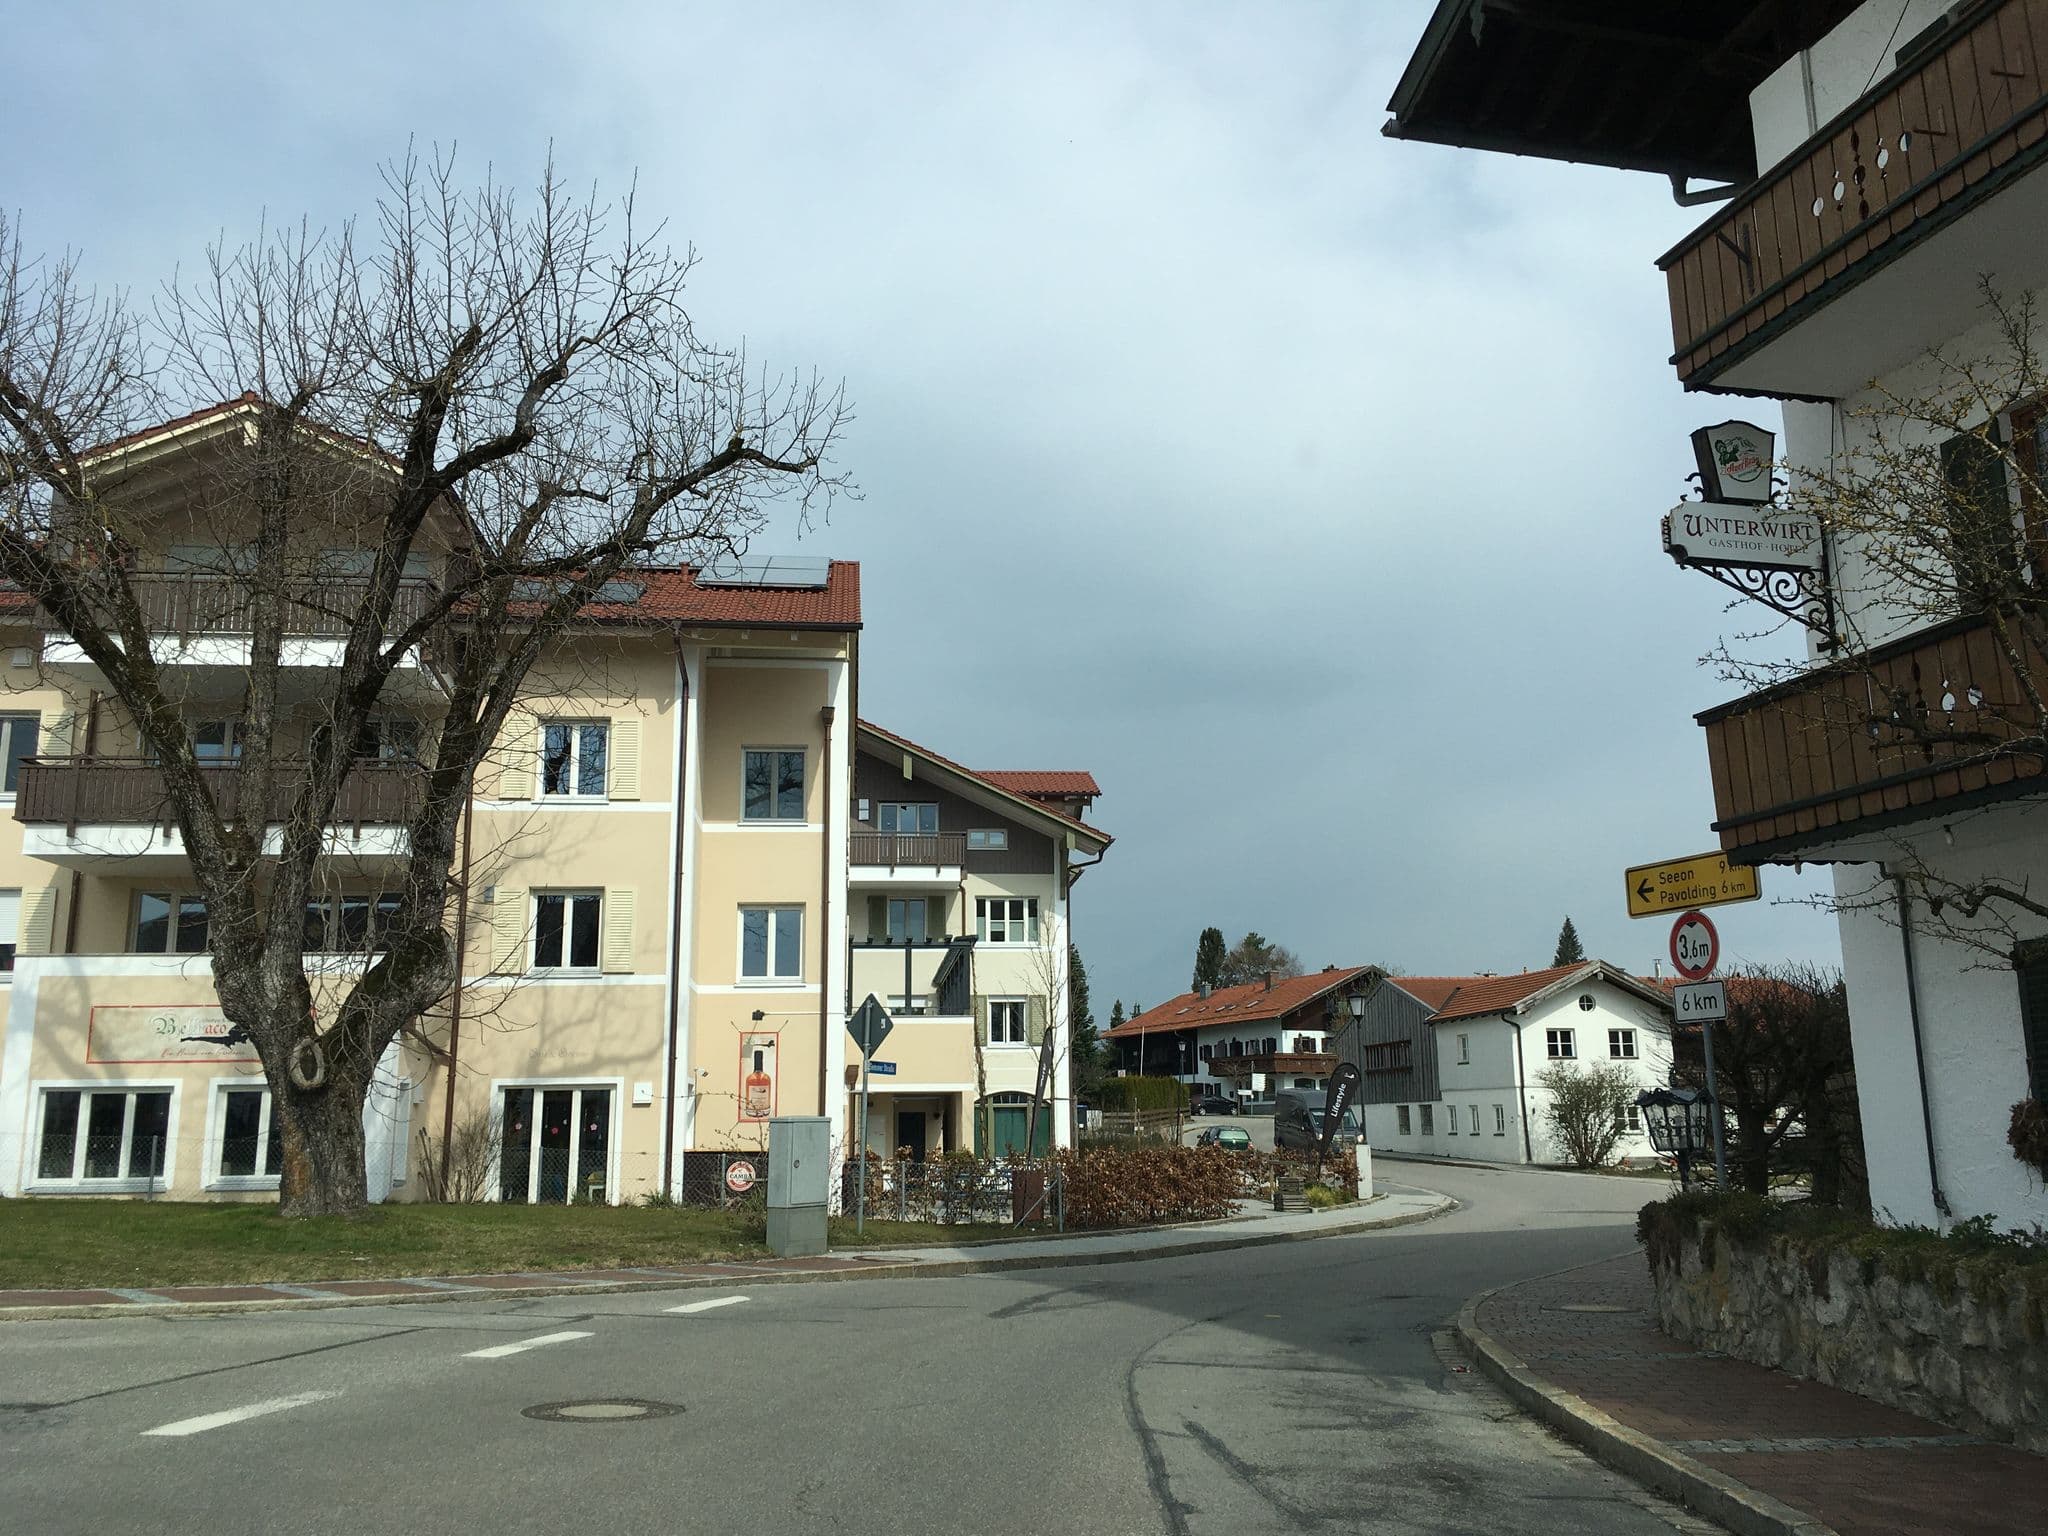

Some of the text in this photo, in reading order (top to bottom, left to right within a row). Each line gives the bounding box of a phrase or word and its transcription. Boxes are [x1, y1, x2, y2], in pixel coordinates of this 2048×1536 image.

[1683, 514, 1814, 541] UNTERWIRT
[1708, 538, 1762, 551] GASTHOF
[1659, 869, 1694, 885] Seeon
[1719, 860, 1726, 874] 9
[1660, 881, 1746, 904] Pavolding 6 km
[1682, 992, 1718, 1011] 6 km
[1330, 1083, 1346, 1118] Lifestyle
